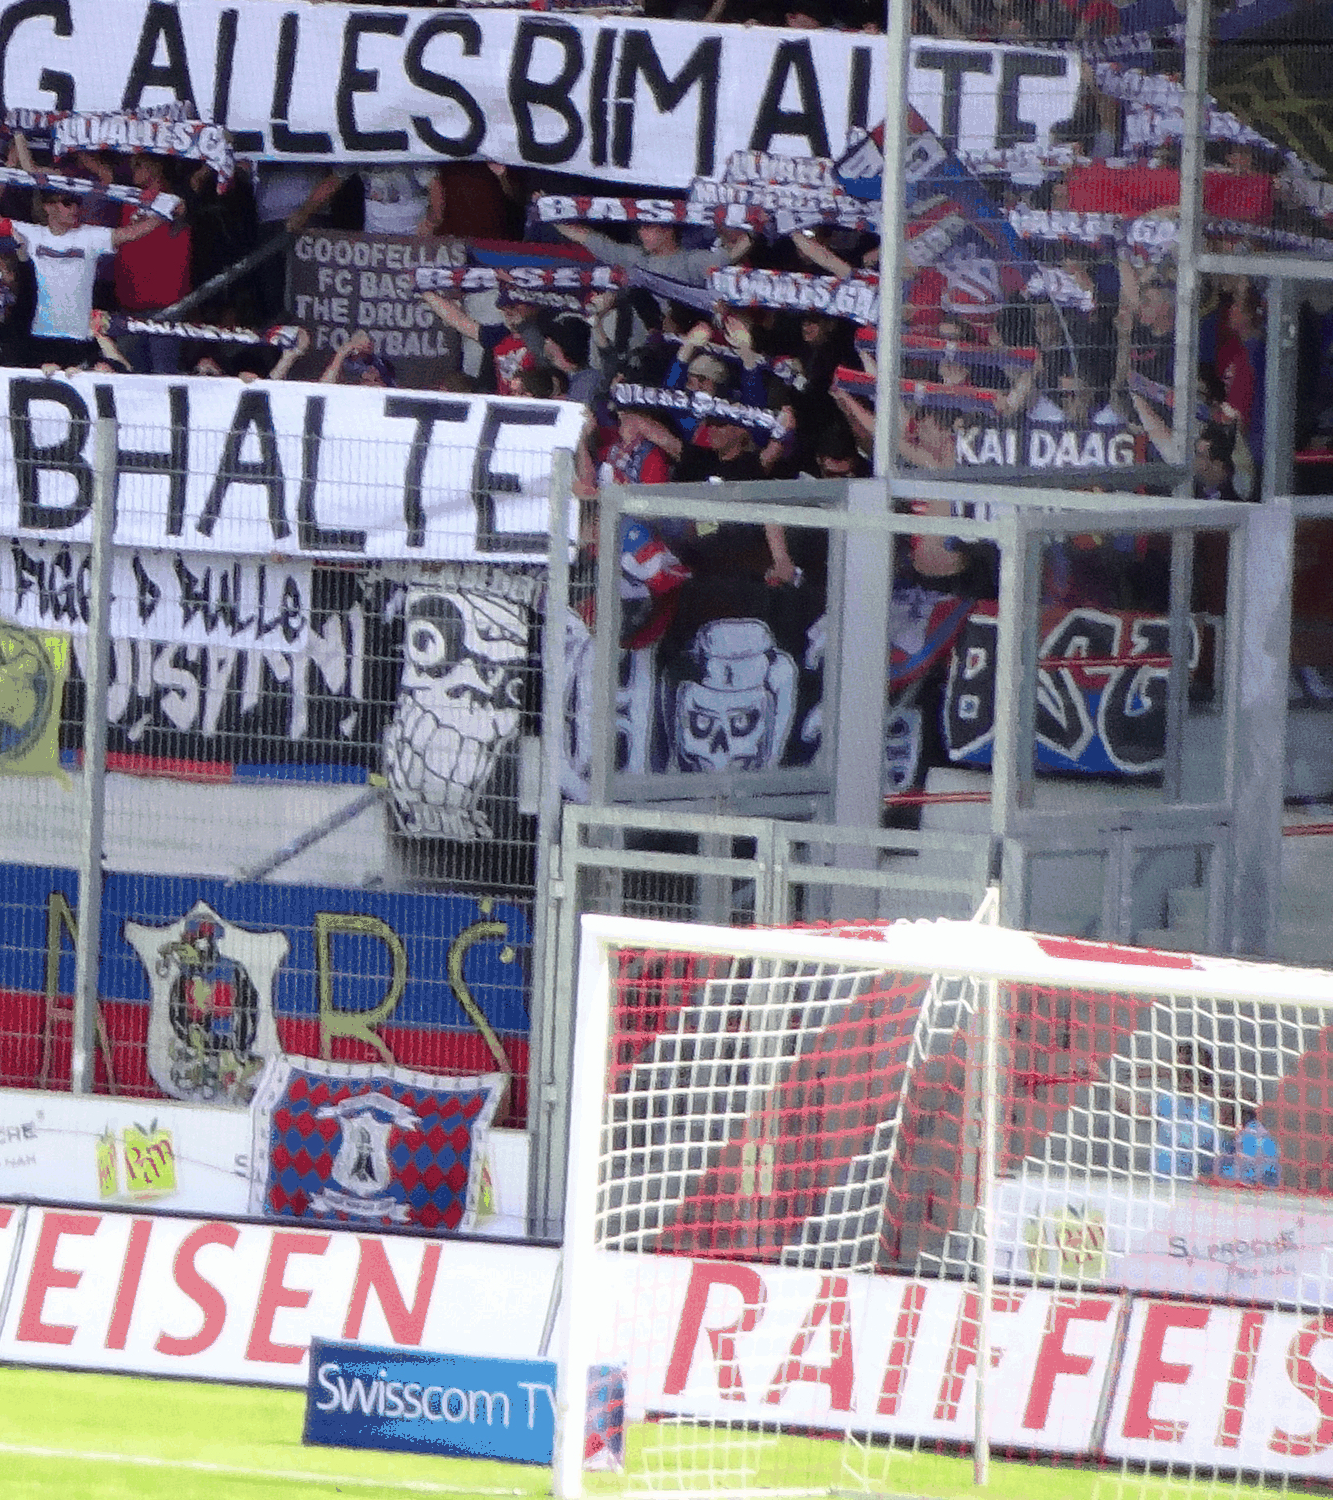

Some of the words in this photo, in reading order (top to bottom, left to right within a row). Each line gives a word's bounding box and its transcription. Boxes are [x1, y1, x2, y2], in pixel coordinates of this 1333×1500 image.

[508, 20, 724, 179] BIM
[294, 234, 468, 269] GOODFELLAS
[317, 268, 353, 293] FC
[295, 297, 350, 324] THE
[315, 328, 451, 358] FOTBALL
[8, 375, 563, 555] BHALTE
[956, 430, 1017, 467] KAI
[1032, 431, 1136, 469] DAAG
[315, 1362, 510, 1430] Swisscom
